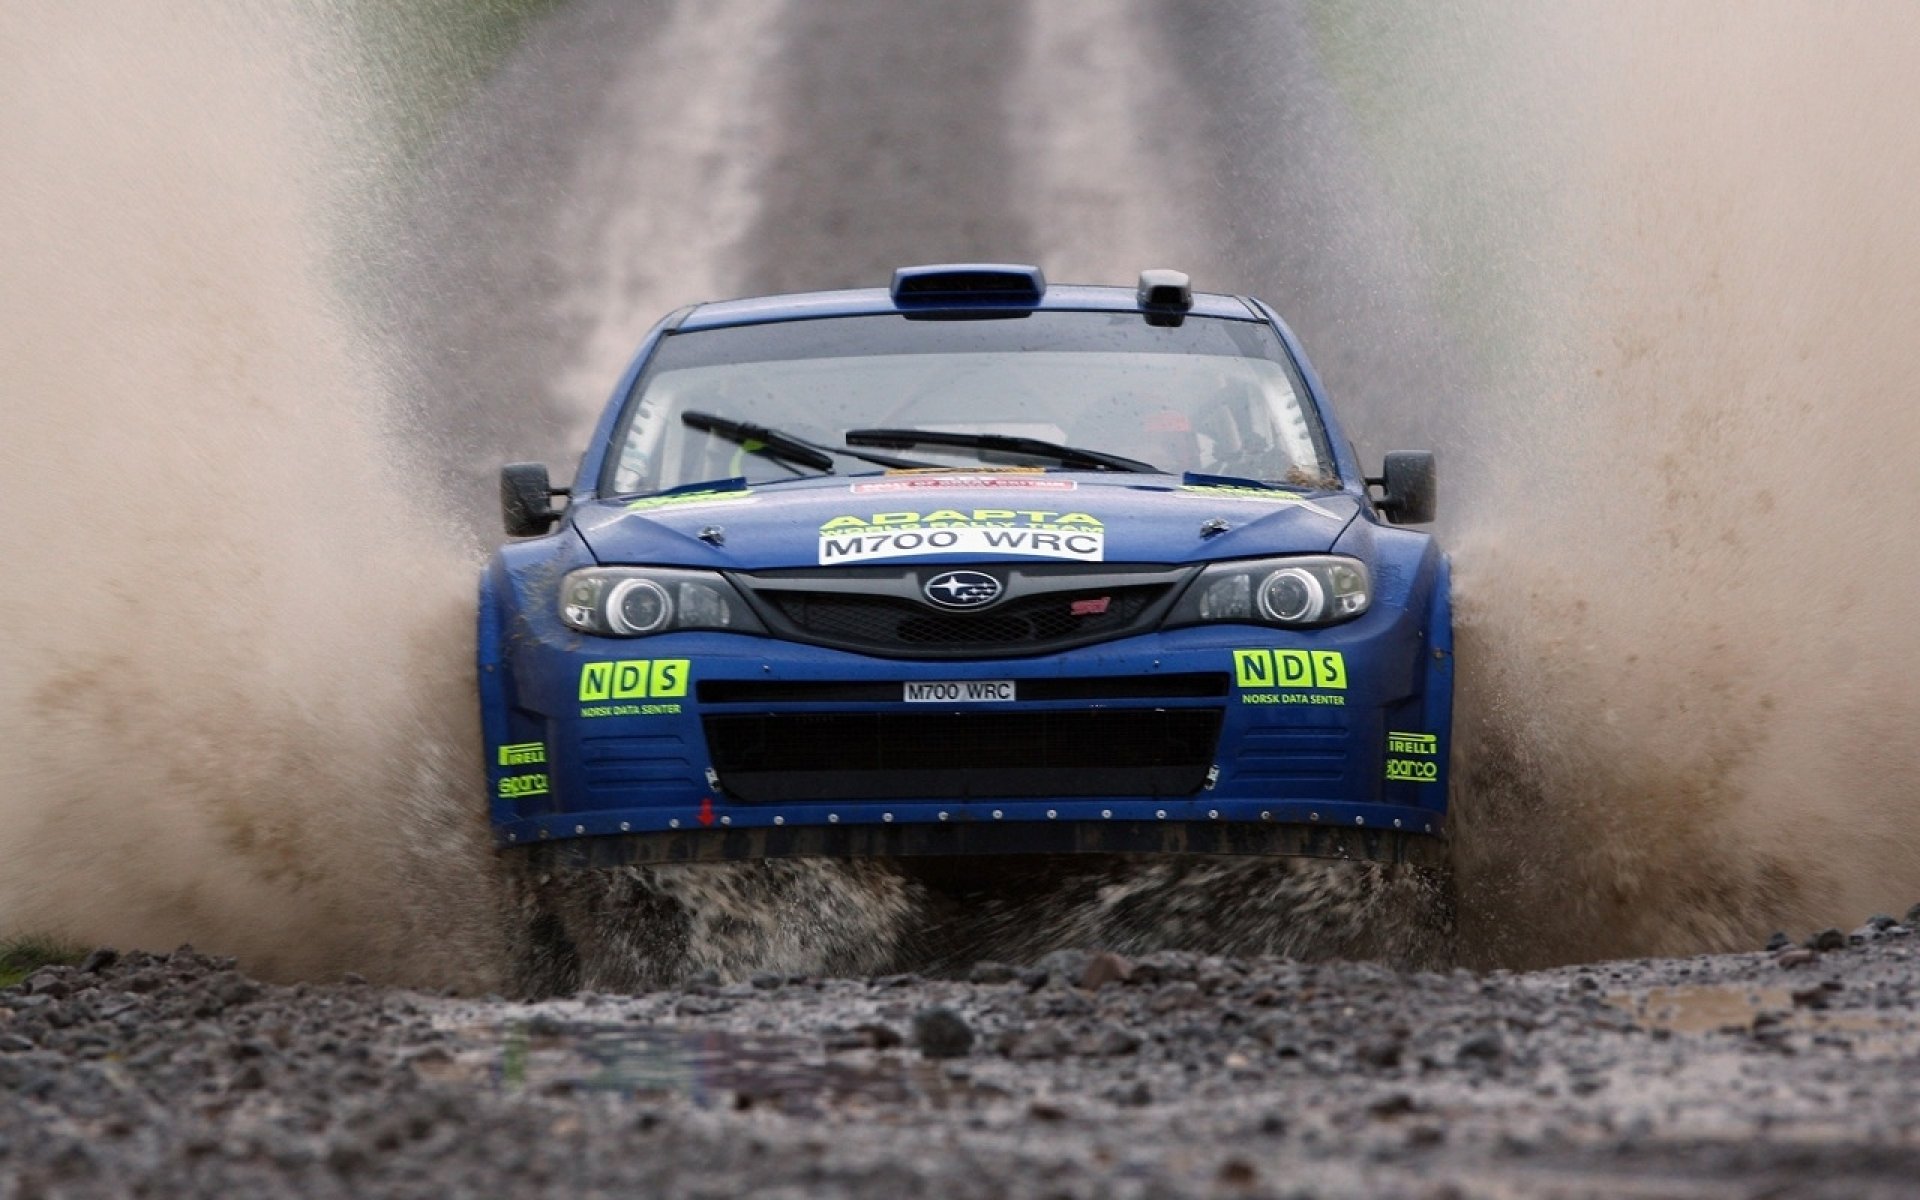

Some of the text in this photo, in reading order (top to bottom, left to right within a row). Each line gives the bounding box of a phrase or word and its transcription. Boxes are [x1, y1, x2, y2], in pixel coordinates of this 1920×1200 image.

[820, 509, 1103, 530] ADAPTA
[825, 530, 1098, 557] M700 WRC
[1241, 654, 1339, 682] NDS
[585, 664, 677, 694] NDS
[908, 683, 1011, 700] M700 WRC
[1242, 693, 1345, 706] NORSK DATA SENTER
[613, 705, 640, 715] DATA
[641, 703, 681, 715] SENTER
